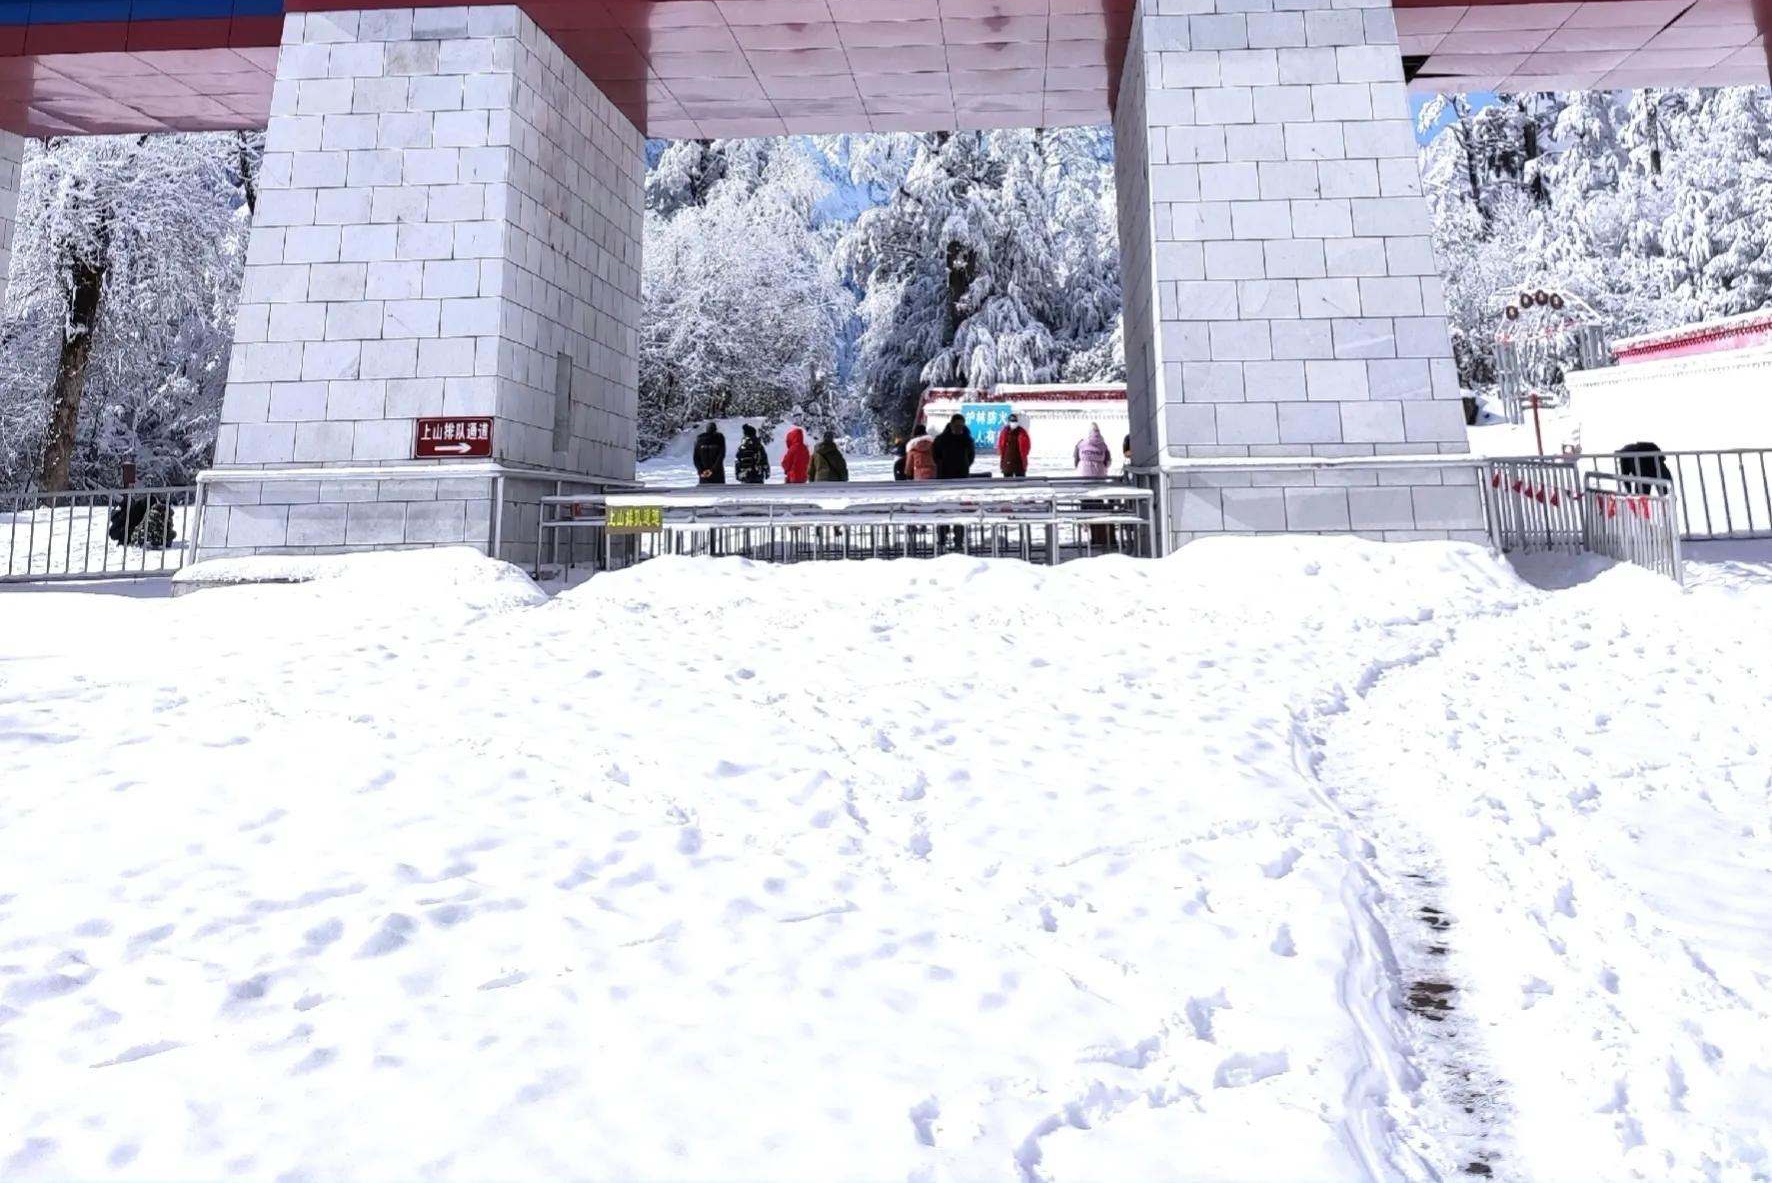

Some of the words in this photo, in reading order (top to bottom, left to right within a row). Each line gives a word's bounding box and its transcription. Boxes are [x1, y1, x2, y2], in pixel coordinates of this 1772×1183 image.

[420, 422, 489, 440] 上山排队通道
